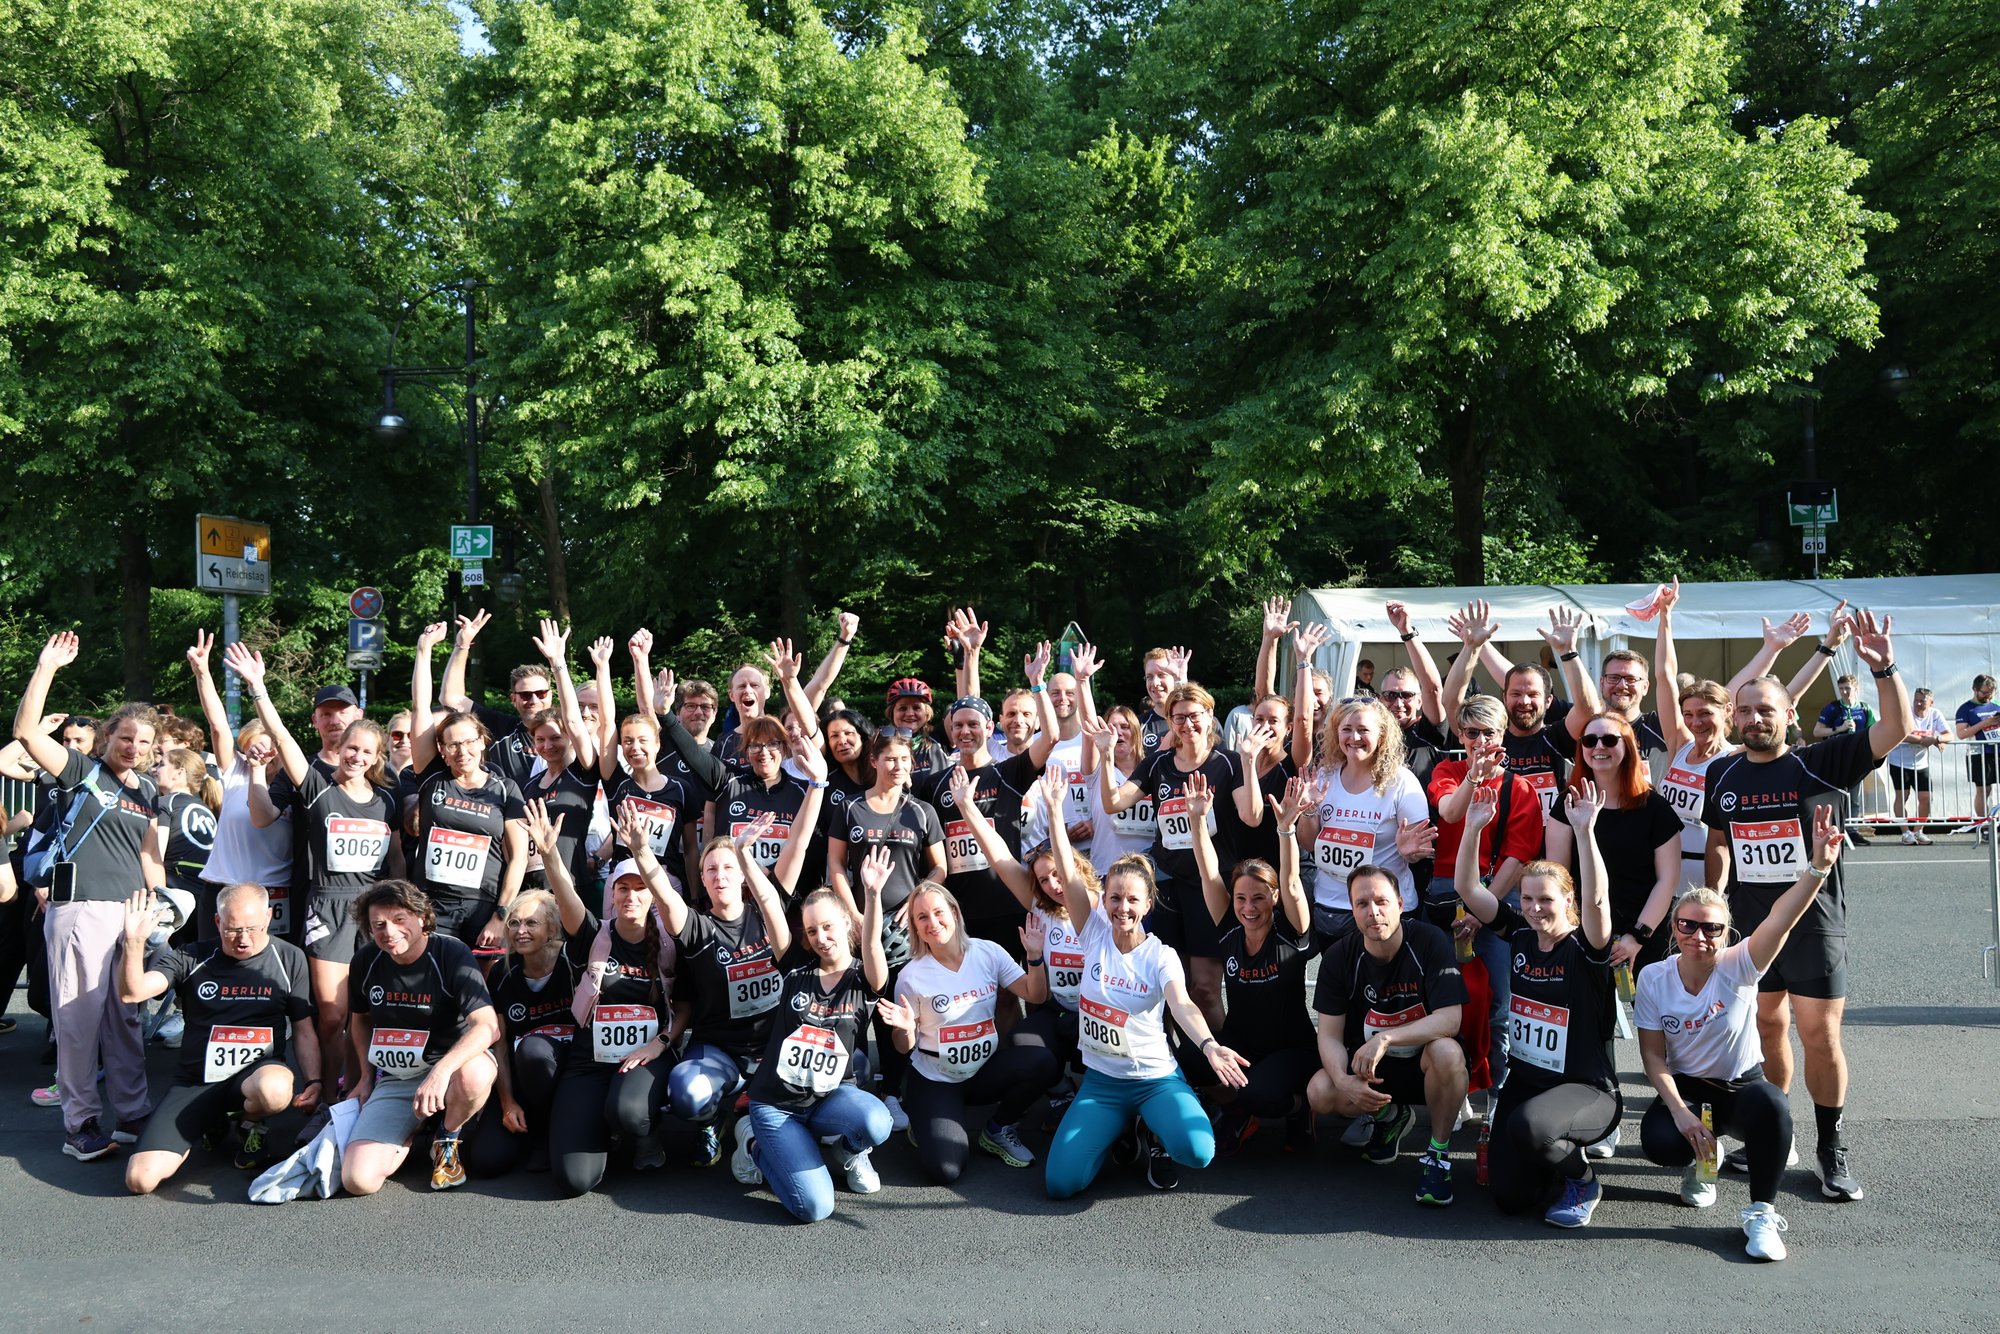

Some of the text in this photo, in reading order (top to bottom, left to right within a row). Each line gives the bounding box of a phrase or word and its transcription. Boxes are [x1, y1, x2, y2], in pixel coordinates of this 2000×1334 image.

[1805, 541, 1824, 551] 610
[226, 567, 265, 584] Reichstag
[464, 573, 483, 582] 608
[357, 623, 377, 648] P
[1510, 755, 1551, 767] BERLIN
[974, 787, 998, 799] RLIN
[1662, 784, 1700, 811] 3097
[1741, 791, 1799, 805] BERLIN
[120, 799, 154, 816] BERLIN
[445, 797, 492, 814] BERLIN
[747, 808, 793, 820] BEIN
[1336, 808, 1382, 821] BERLIN
[867, 828, 915, 839] BELIN
[335, 838, 382, 856] 3062
[751, 841, 781, 859] 109
[950, 839, 983, 859] 305
[1742, 843, 1797, 865] 3102
[431, 847, 478, 871] 3100
[1321, 845, 1365, 869] 3052
[620, 962, 649, 977] BERL
[1240, 962, 1278, 979] BERLIN
[1524, 964, 1565, 977] BERLIN
[221, 986, 273, 996] BERLIN
[737, 973, 780, 1003] 3095
[1103, 974, 1149, 994] BERLIN
[386, 991, 432, 1003] BERLIN
[953, 983, 997, 1004] BERLIN
[529, 997, 573, 1014] BERLIN
[809, 1002, 854, 1016] BERLIN
[1684, 999, 1725, 1030] BEIN
[601, 1024, 648, 1047] 3081
[1083, 1015, 1121, 1047] 3080
[1513, 1018, 1558, 1052] 3110
[214, 1047, 265, 1067] 3123
[375, 1050, 419, 1068] 3092
[788, 1045, 839, 1076] 3099
[947, 1040, 992, 1065] 3089
